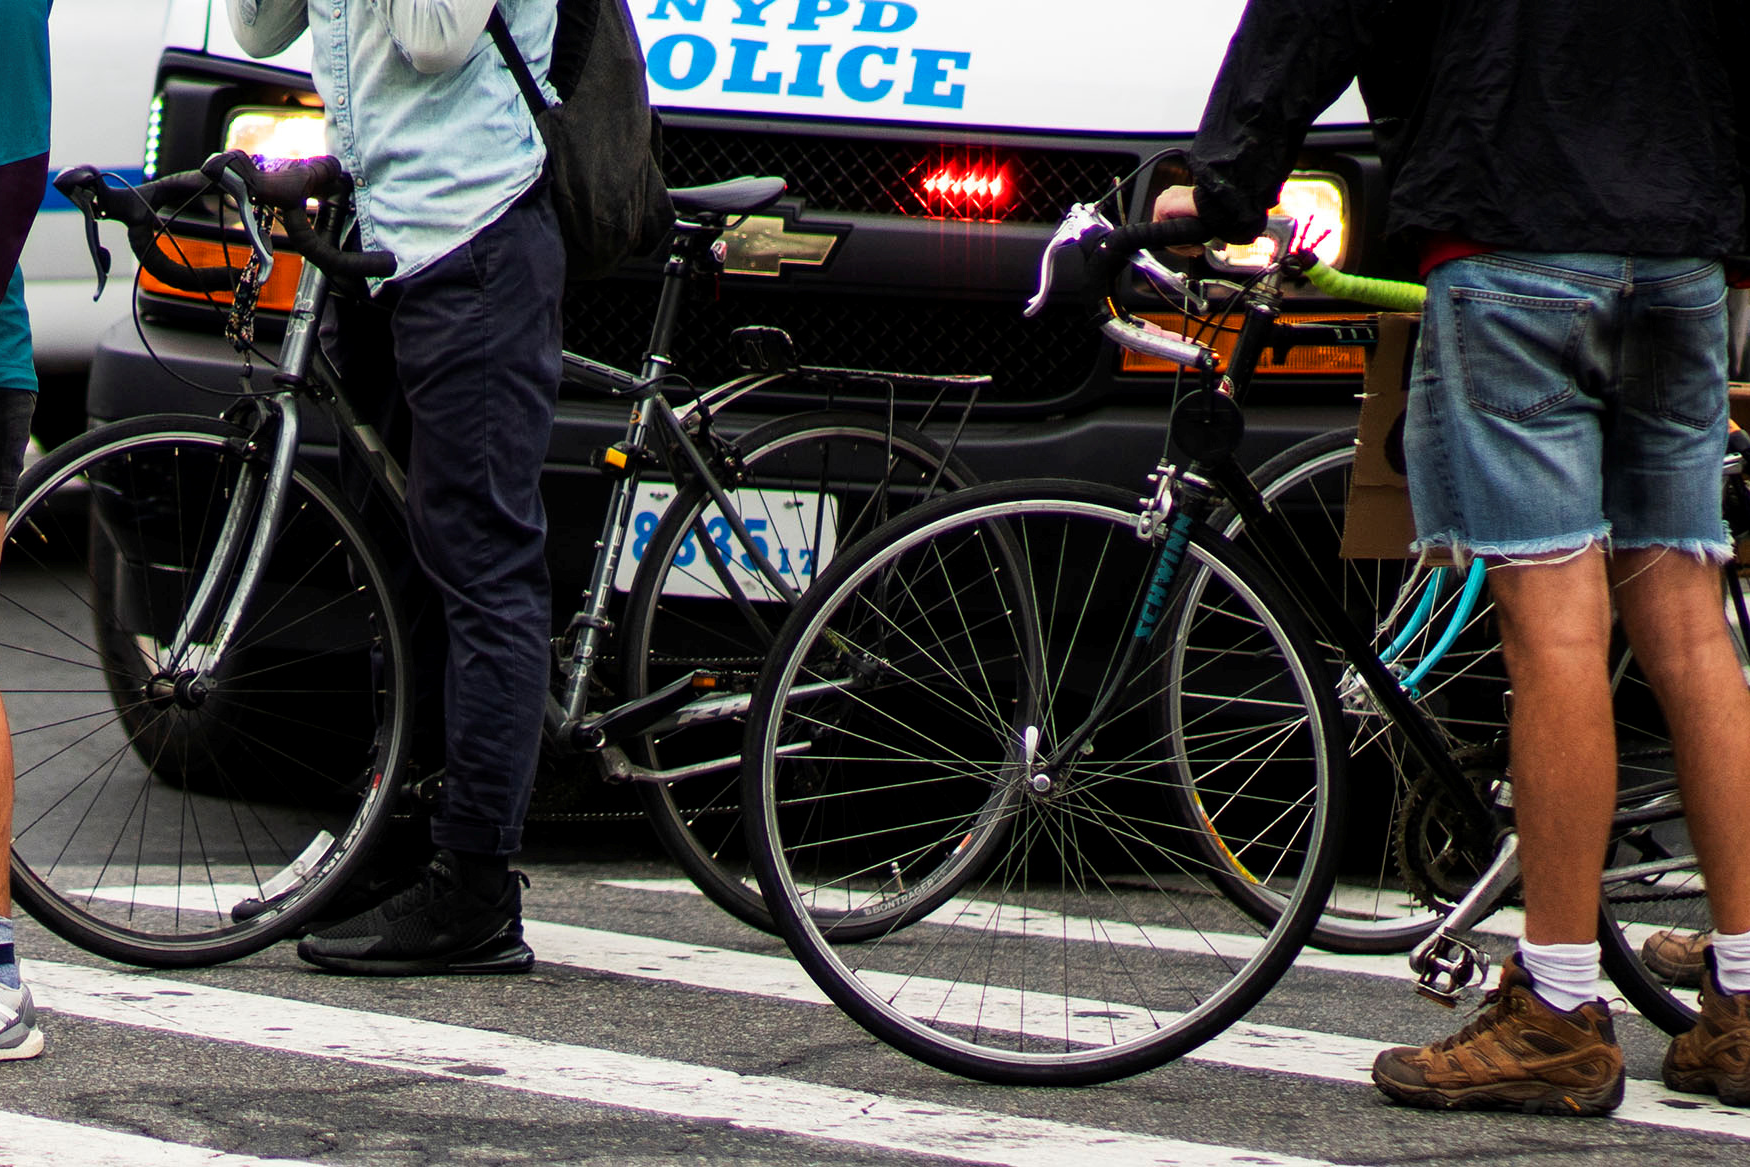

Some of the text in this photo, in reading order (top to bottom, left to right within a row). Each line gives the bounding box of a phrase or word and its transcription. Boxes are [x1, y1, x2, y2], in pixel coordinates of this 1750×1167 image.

[646, 32, 972, 110] OLICE
[1134, 511, 1194, 641] SCHWINN
[871, 875, 935, 915] BONTRAGER
